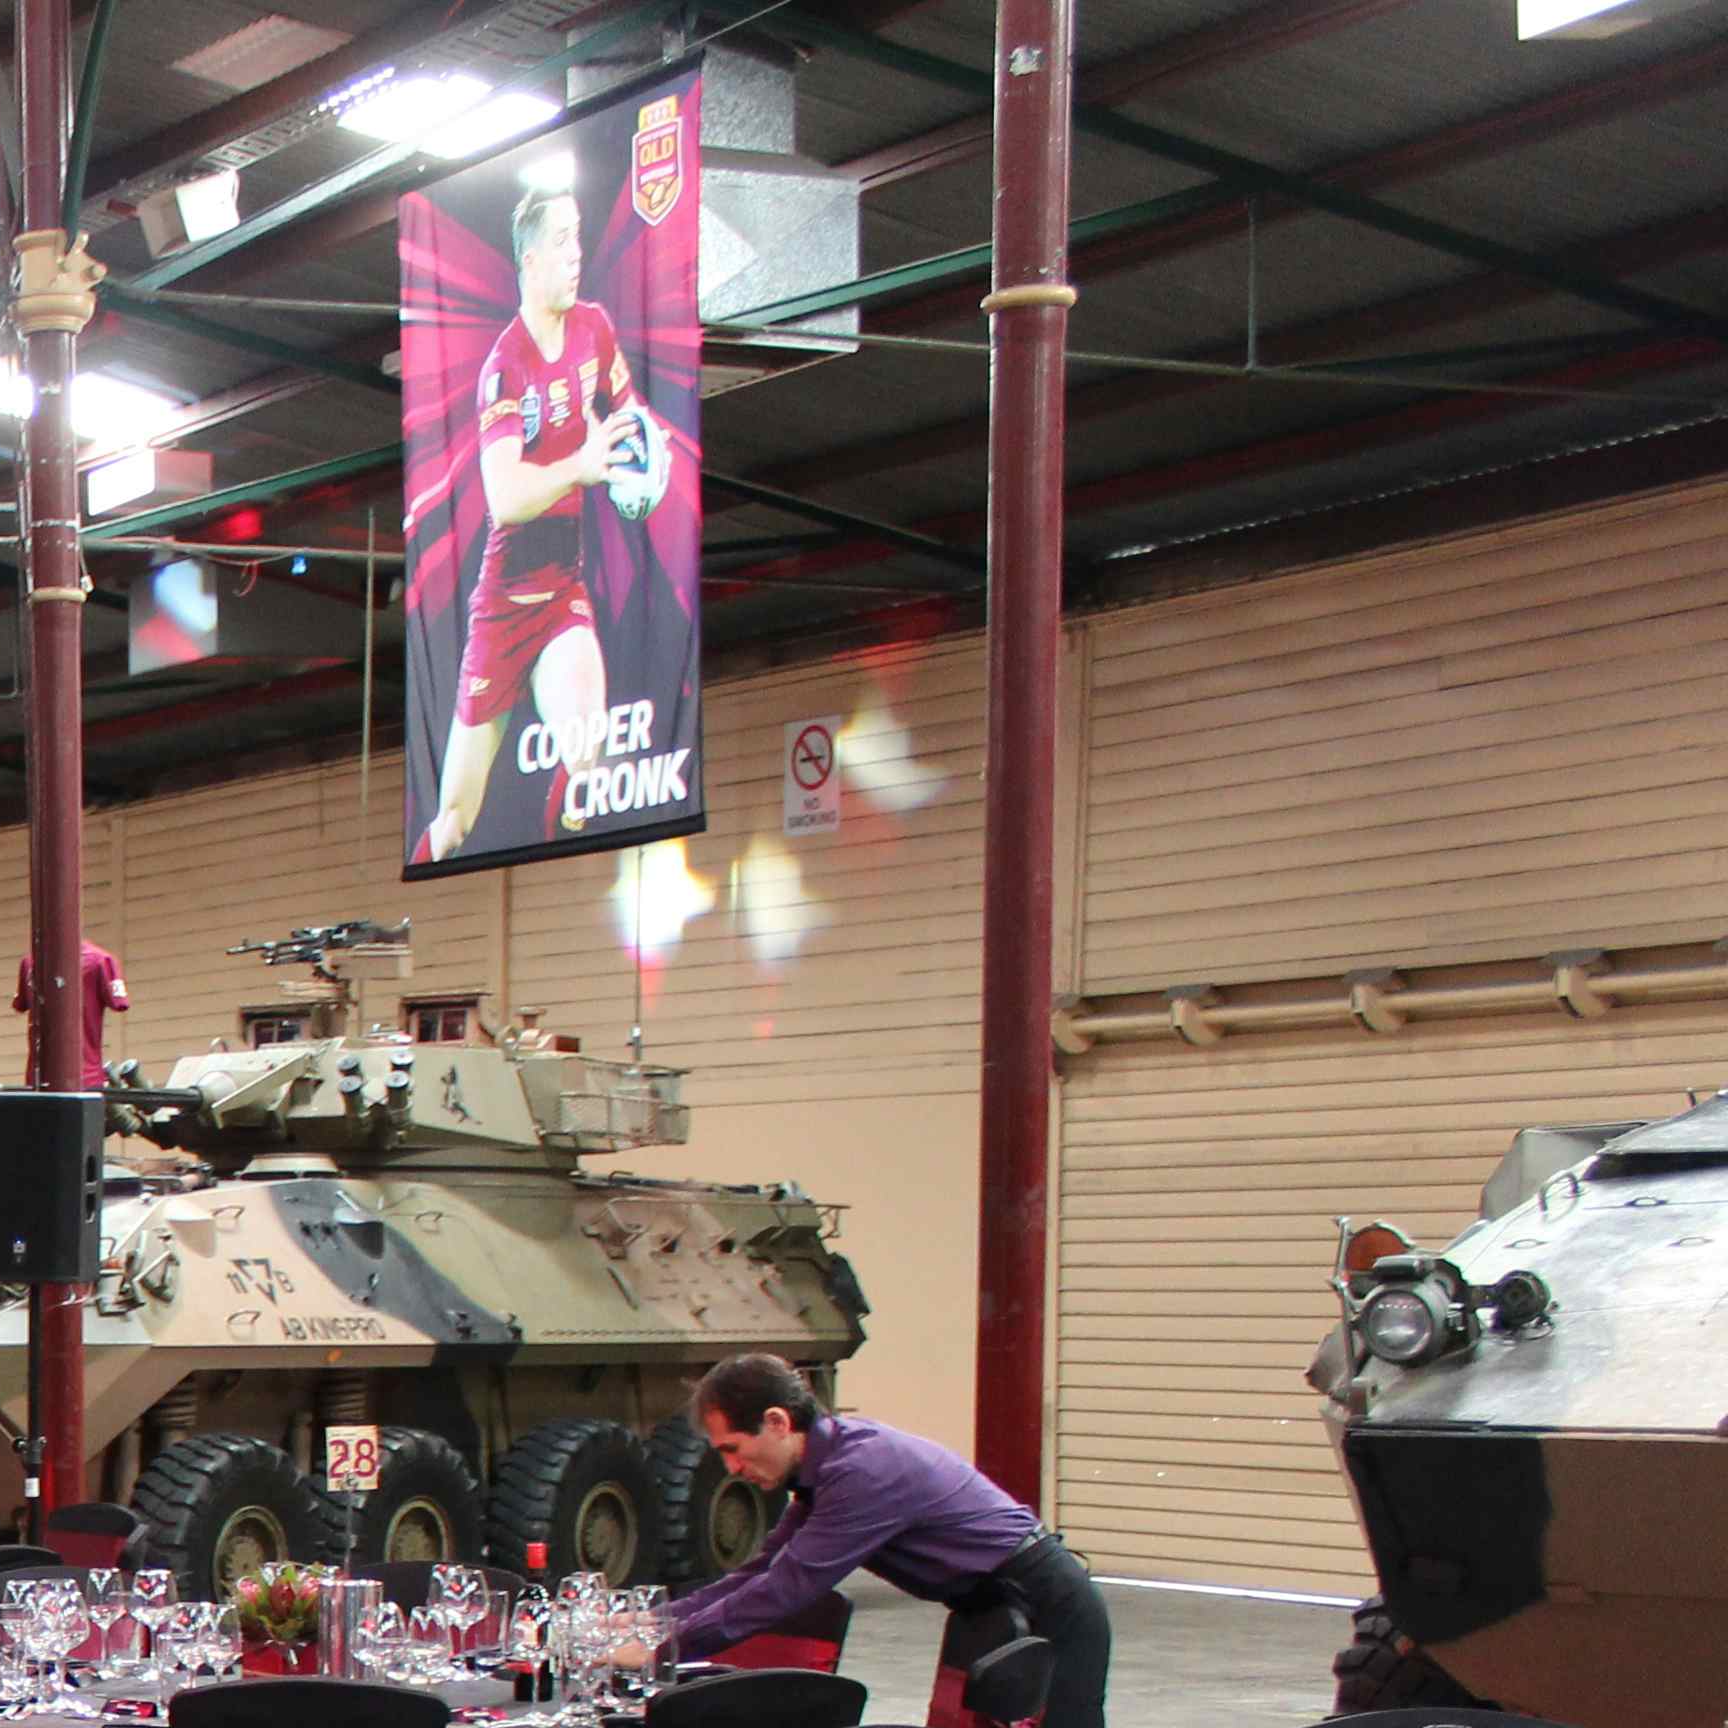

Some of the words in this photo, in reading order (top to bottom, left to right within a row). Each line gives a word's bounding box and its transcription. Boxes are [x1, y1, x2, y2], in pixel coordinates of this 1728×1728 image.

[517, 699, 654, 775] COOPER
[564, 748, 691, 820] CRONK
[329, 1439, 376, 1478] 28
